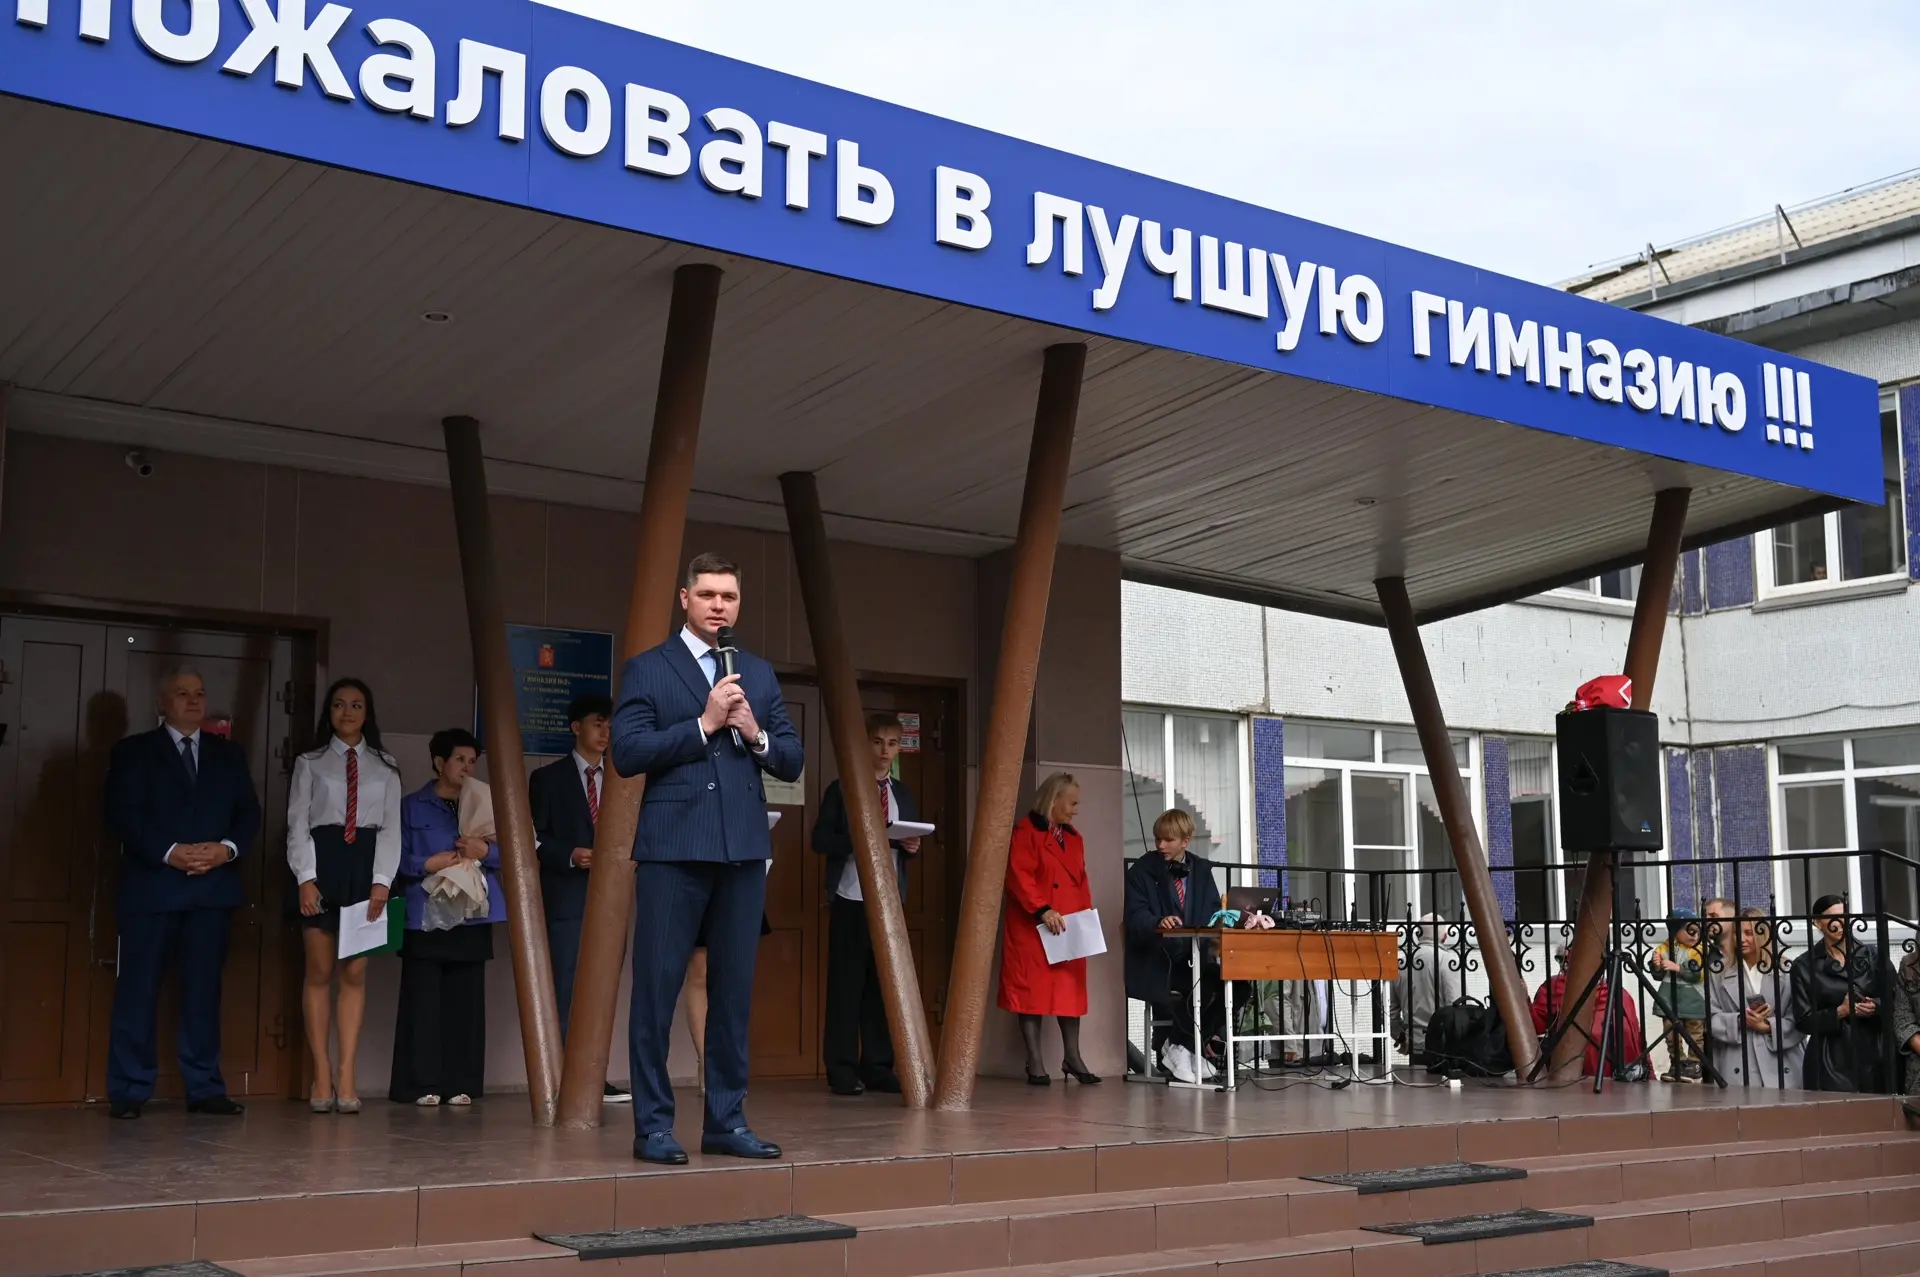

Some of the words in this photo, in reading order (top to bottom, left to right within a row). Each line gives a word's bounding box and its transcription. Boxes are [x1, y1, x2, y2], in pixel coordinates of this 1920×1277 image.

[936, 165, 993, 251] в
[1026, 191, 1384, 352] лучшую
[1411, 289, 1747, 432] гимназию
[1763, 362, 1814, 451] !!!
